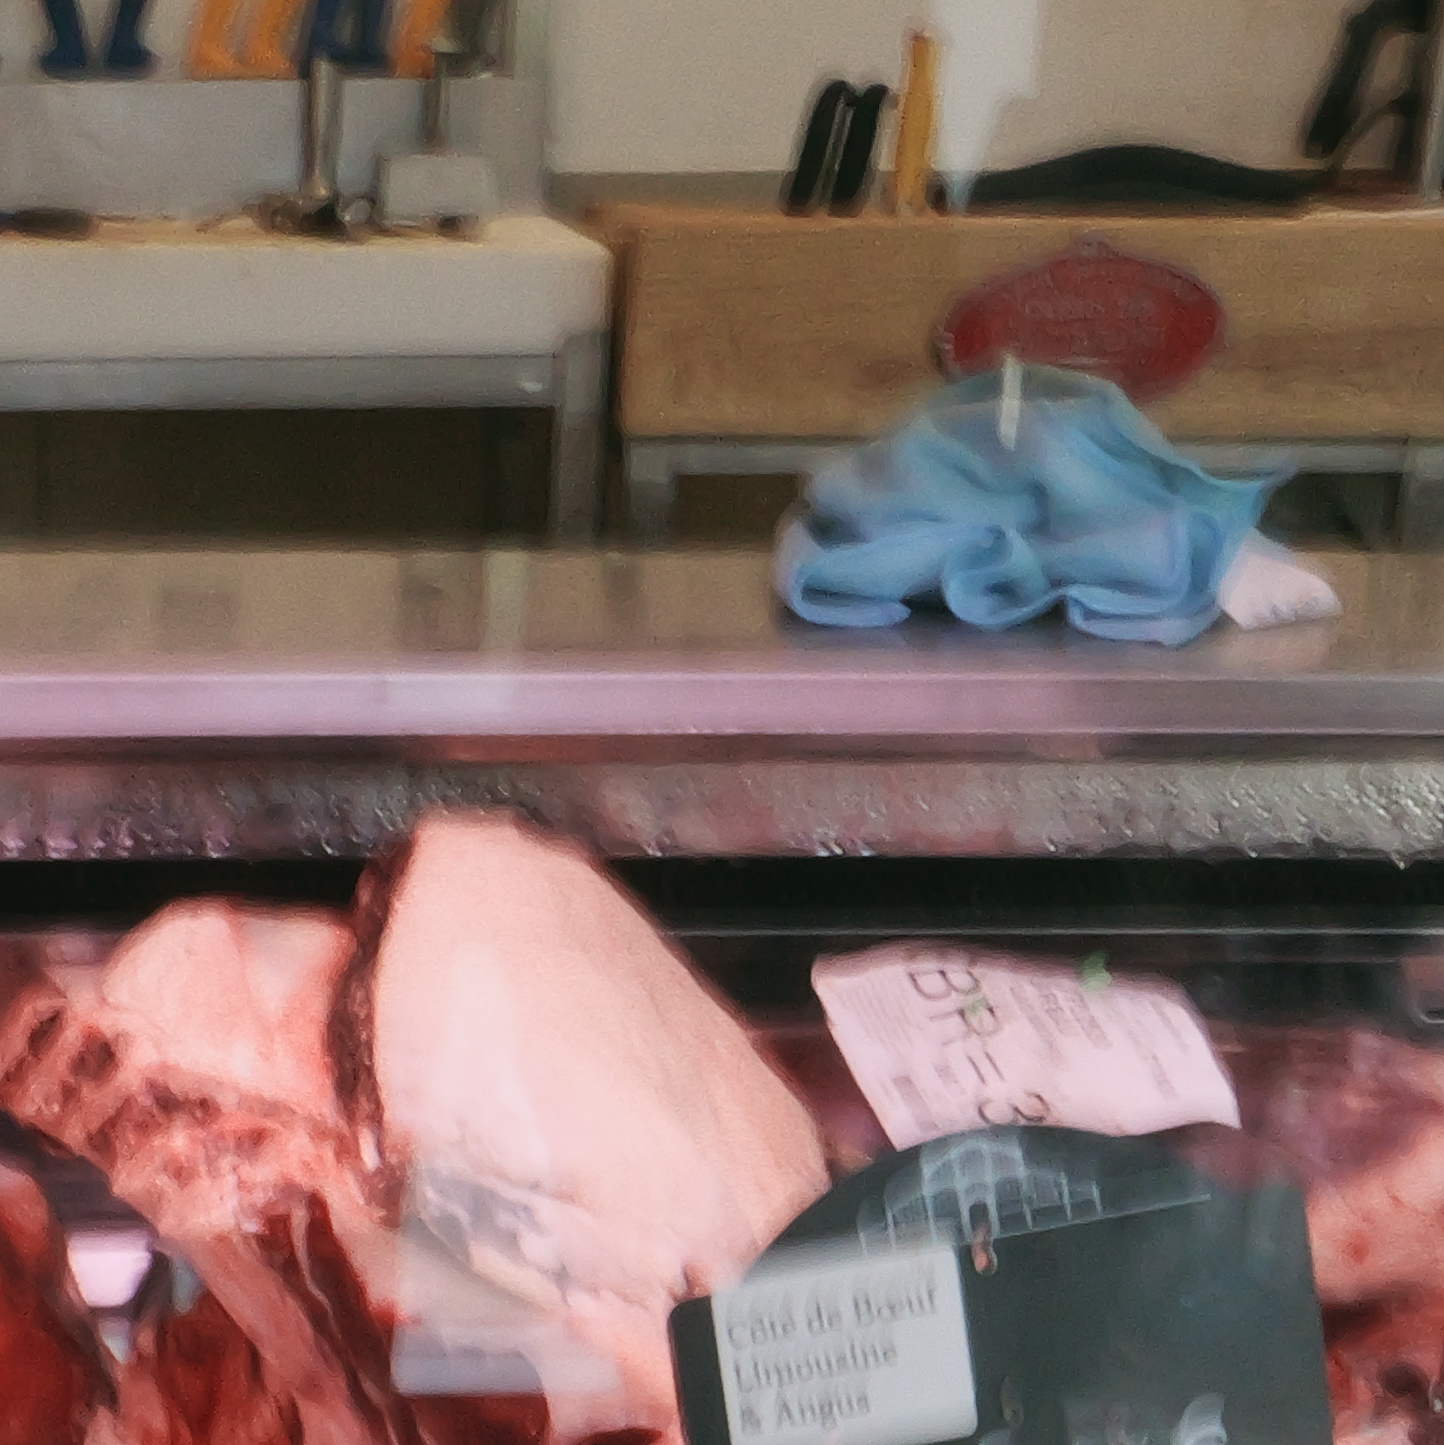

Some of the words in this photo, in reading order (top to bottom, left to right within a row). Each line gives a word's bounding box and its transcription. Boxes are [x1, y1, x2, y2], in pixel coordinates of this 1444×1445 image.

[805, 1298, 845, 1337] de
[734, 1340, 900, 1393] Limousine
[774, 1389, 872, 1431] Angus
